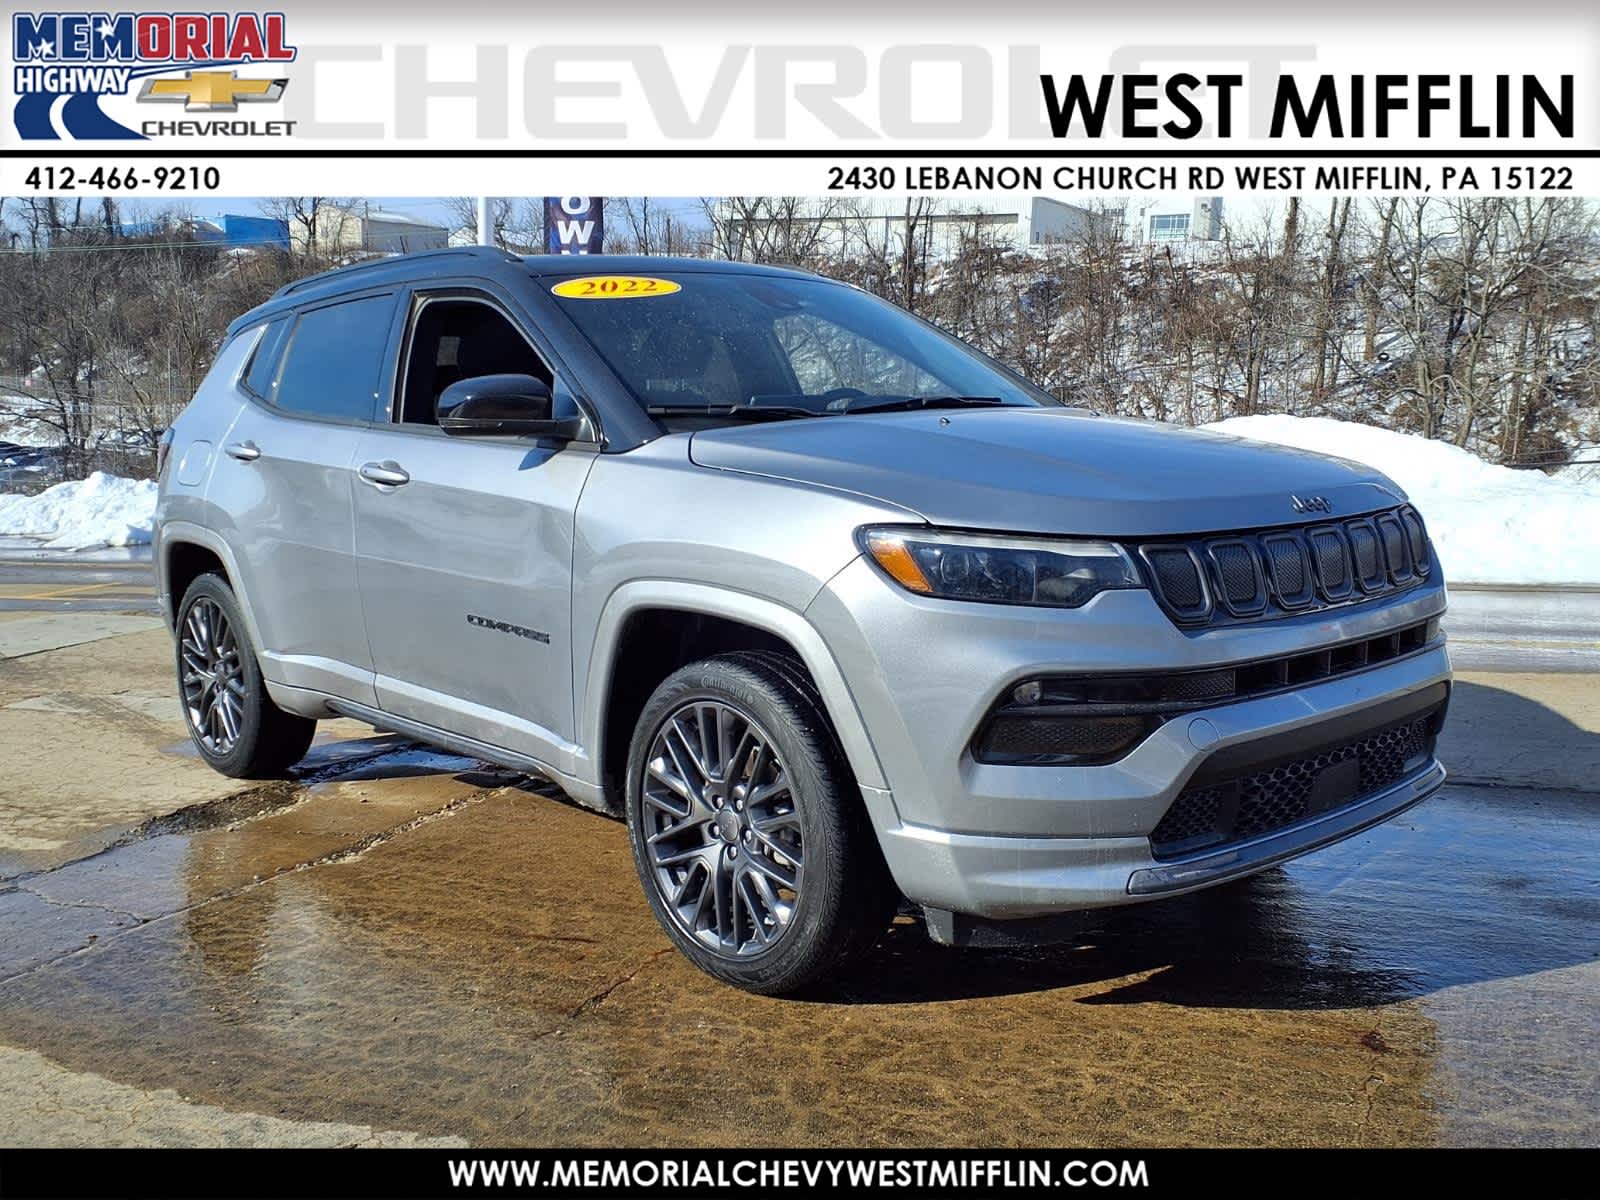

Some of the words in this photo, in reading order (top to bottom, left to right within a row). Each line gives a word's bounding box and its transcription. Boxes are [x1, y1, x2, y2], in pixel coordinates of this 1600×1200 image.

[582, 280, 657, 295] 2022
[1291, 495, 1331, 513] Jeep
[467, 614, 550, 644] COMPASS
